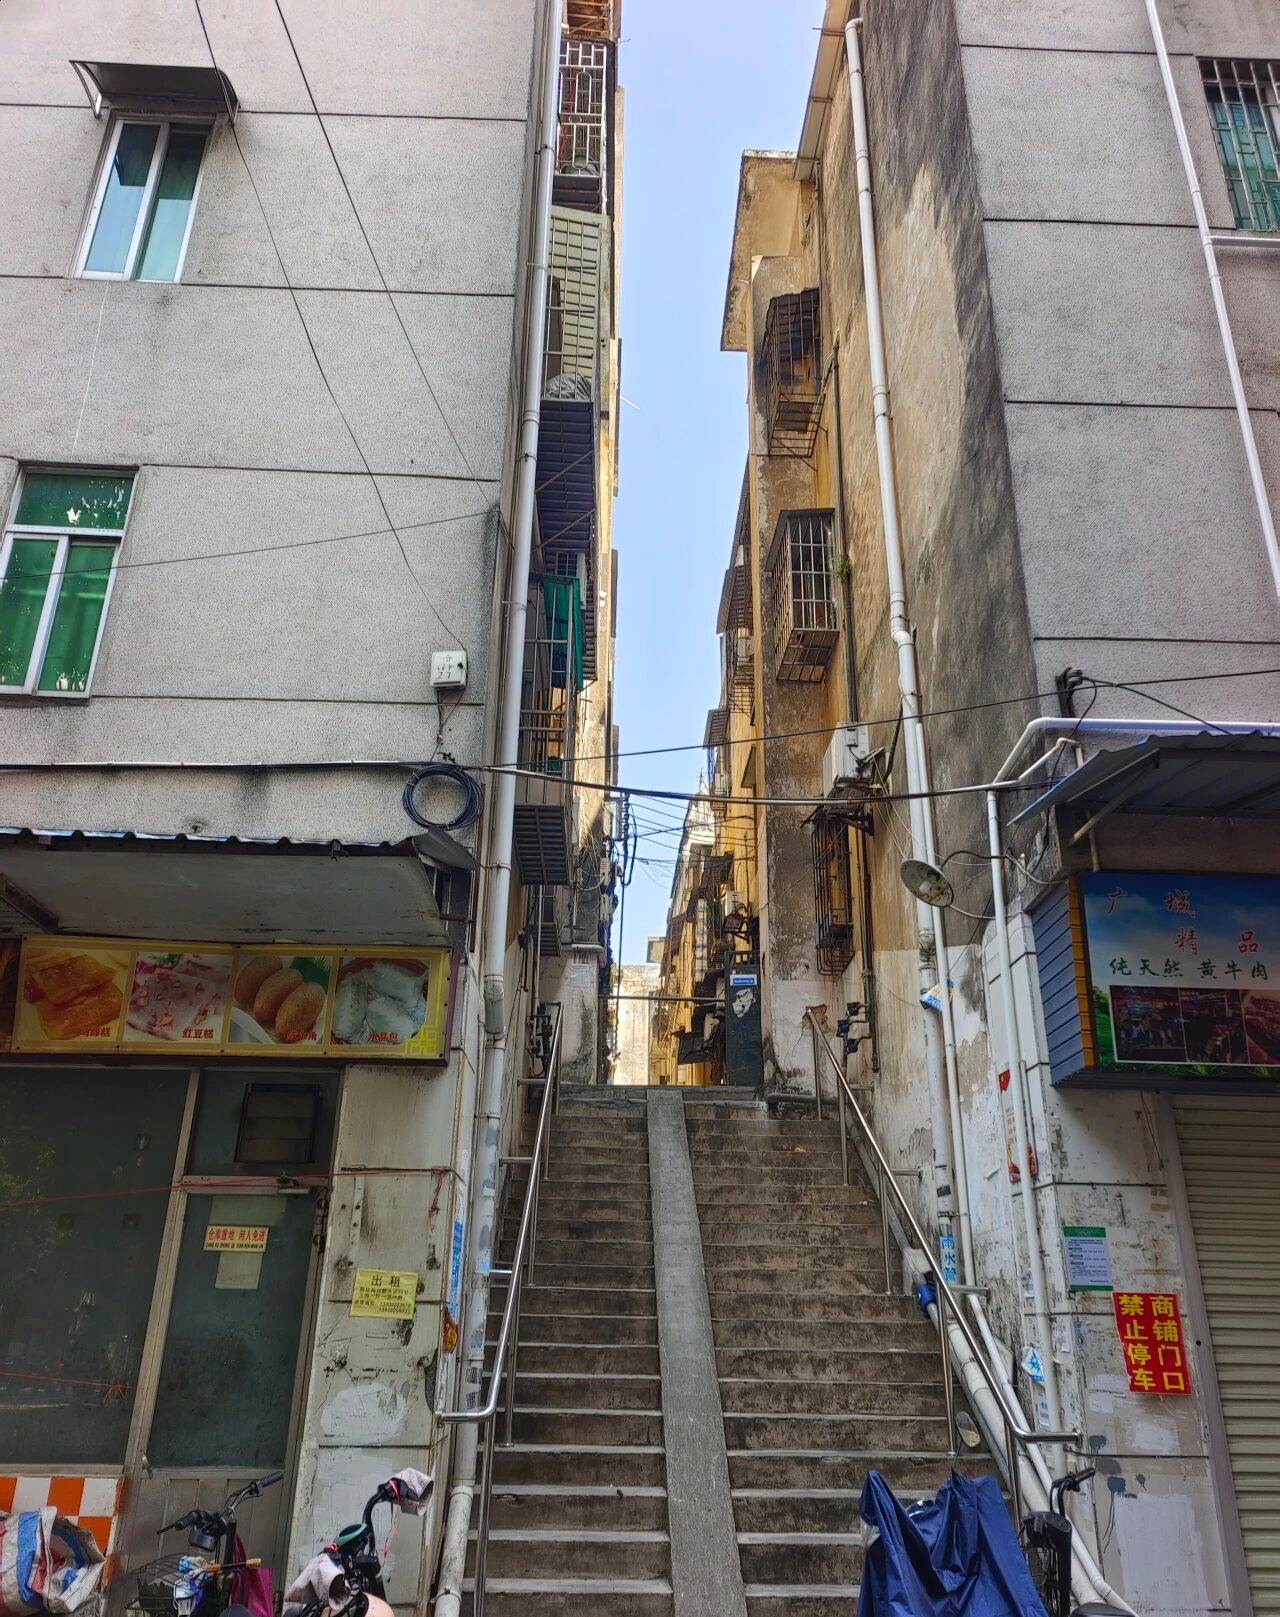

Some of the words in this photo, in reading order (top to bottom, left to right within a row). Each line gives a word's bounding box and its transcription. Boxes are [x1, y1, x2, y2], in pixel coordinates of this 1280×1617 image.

[182, 1027, 214, 1039] 红豆糕
[368, 1031, 398, 1042] 水晶包
[942, 1236, 957, 1281] 雨水管
[371, 1274, 401, 1288] 出租
[1118, 1294, 1156, 1391] 禁止停车
[1149, 1295, 1185, 1391] 商铺门口
